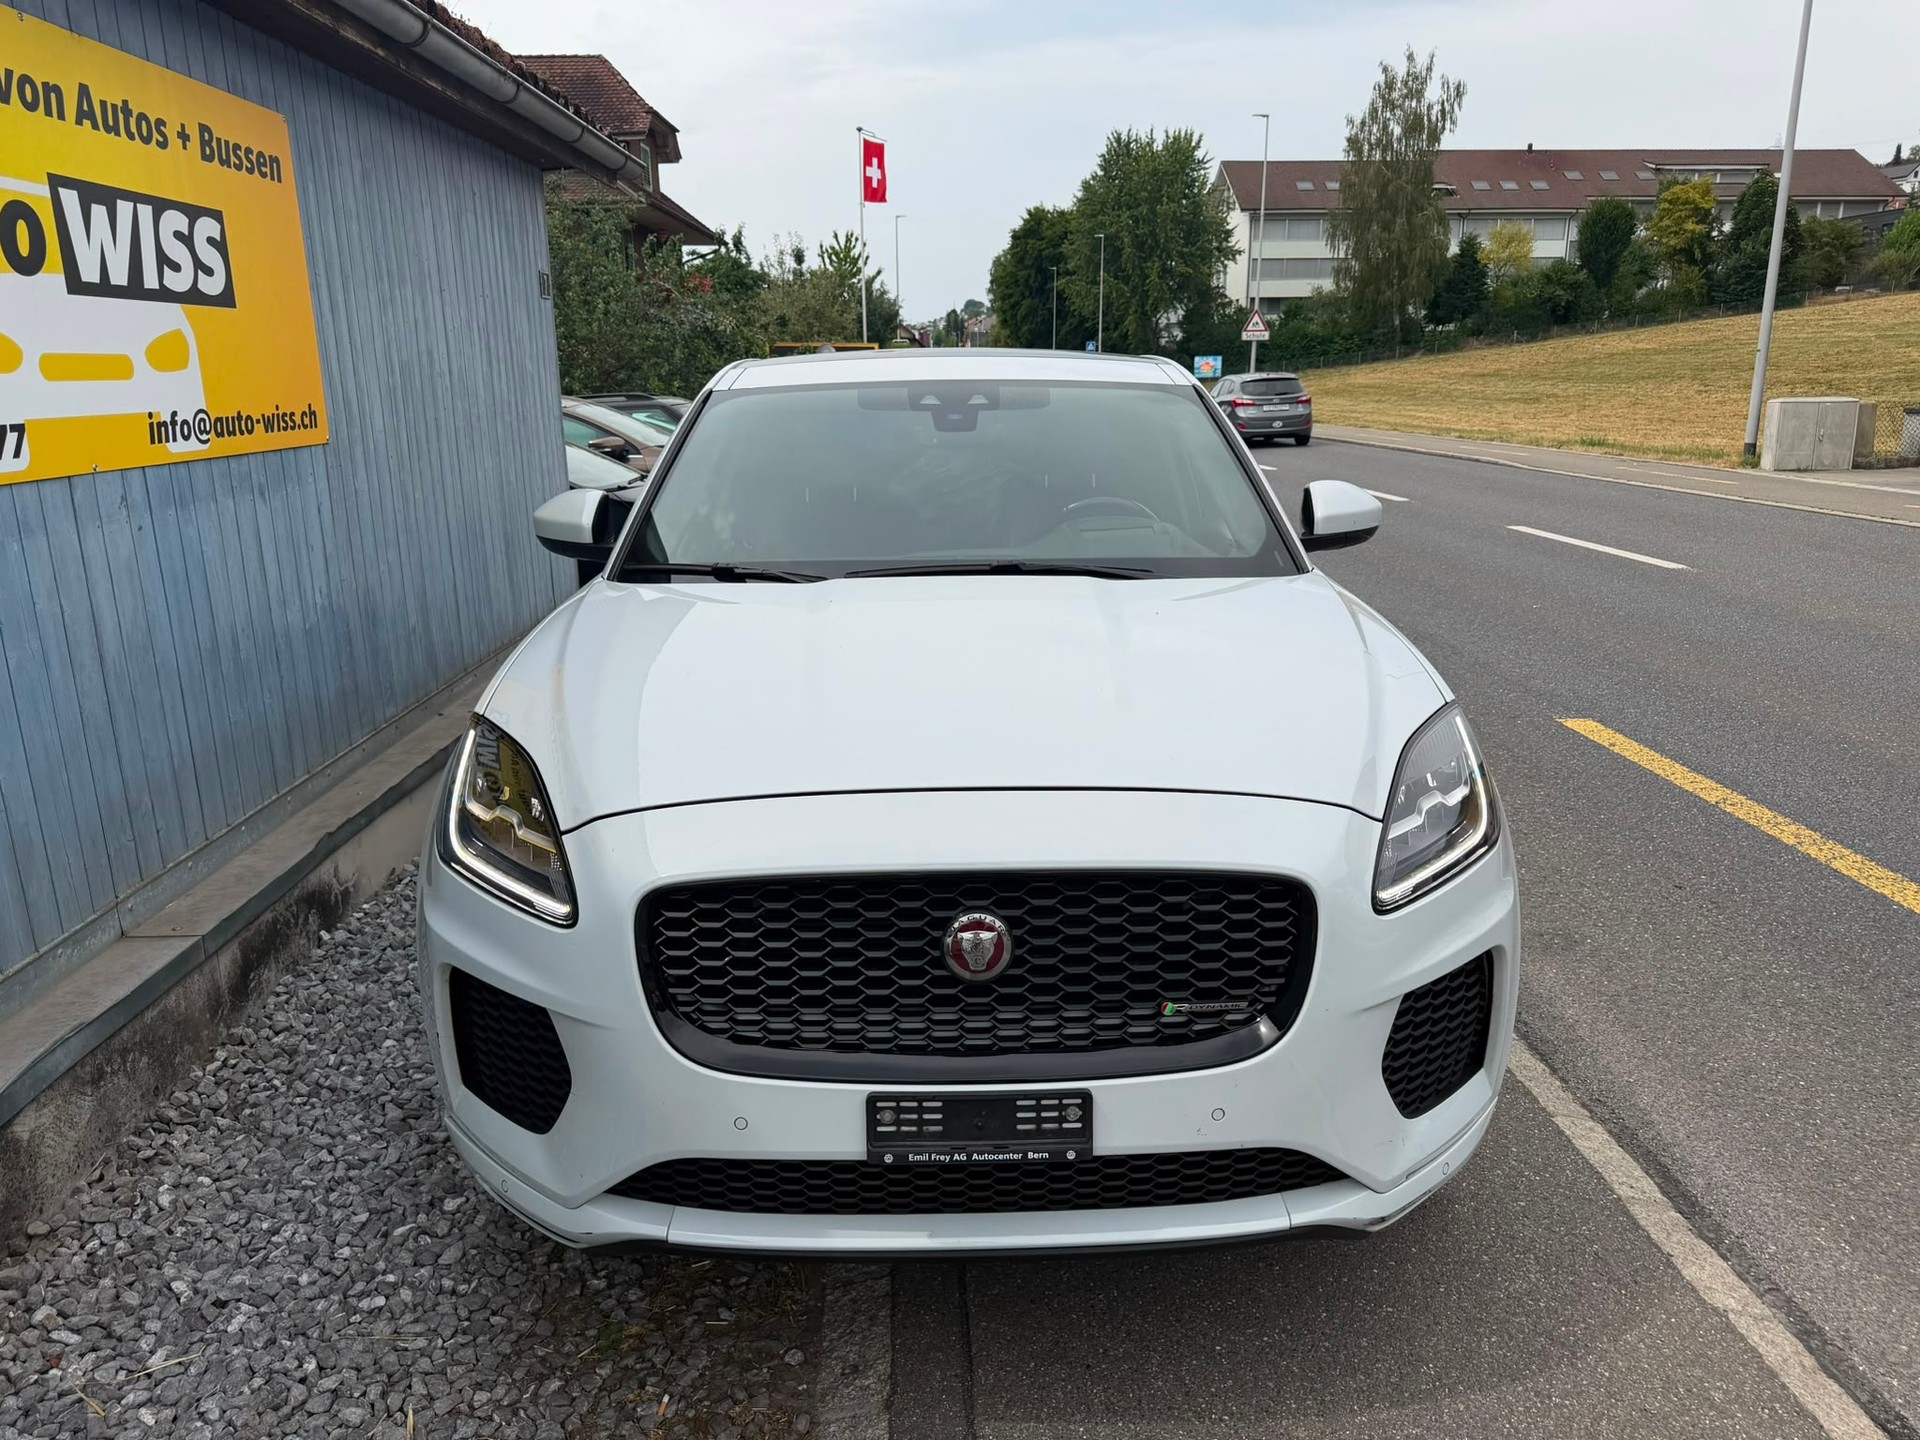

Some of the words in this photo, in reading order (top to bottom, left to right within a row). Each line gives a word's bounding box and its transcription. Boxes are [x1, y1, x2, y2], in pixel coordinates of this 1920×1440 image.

[75, 82, 169, 150] Autos
[177, 123, 190, 150] +
[198, 122, 282, 183] Bussen
[58, 186, 226, 296] WISS
[148, 403, 318, 445] info@auto-wiss.ch
[908, 1153, 929, 1161] Emil
[931, 1153, 951, 1162] Frey
[953, 1153, 967, 1161] AG
[971, 1152, 1023, 1161] Autocenter
[1027, 1151, 1049, 1159] Bern
